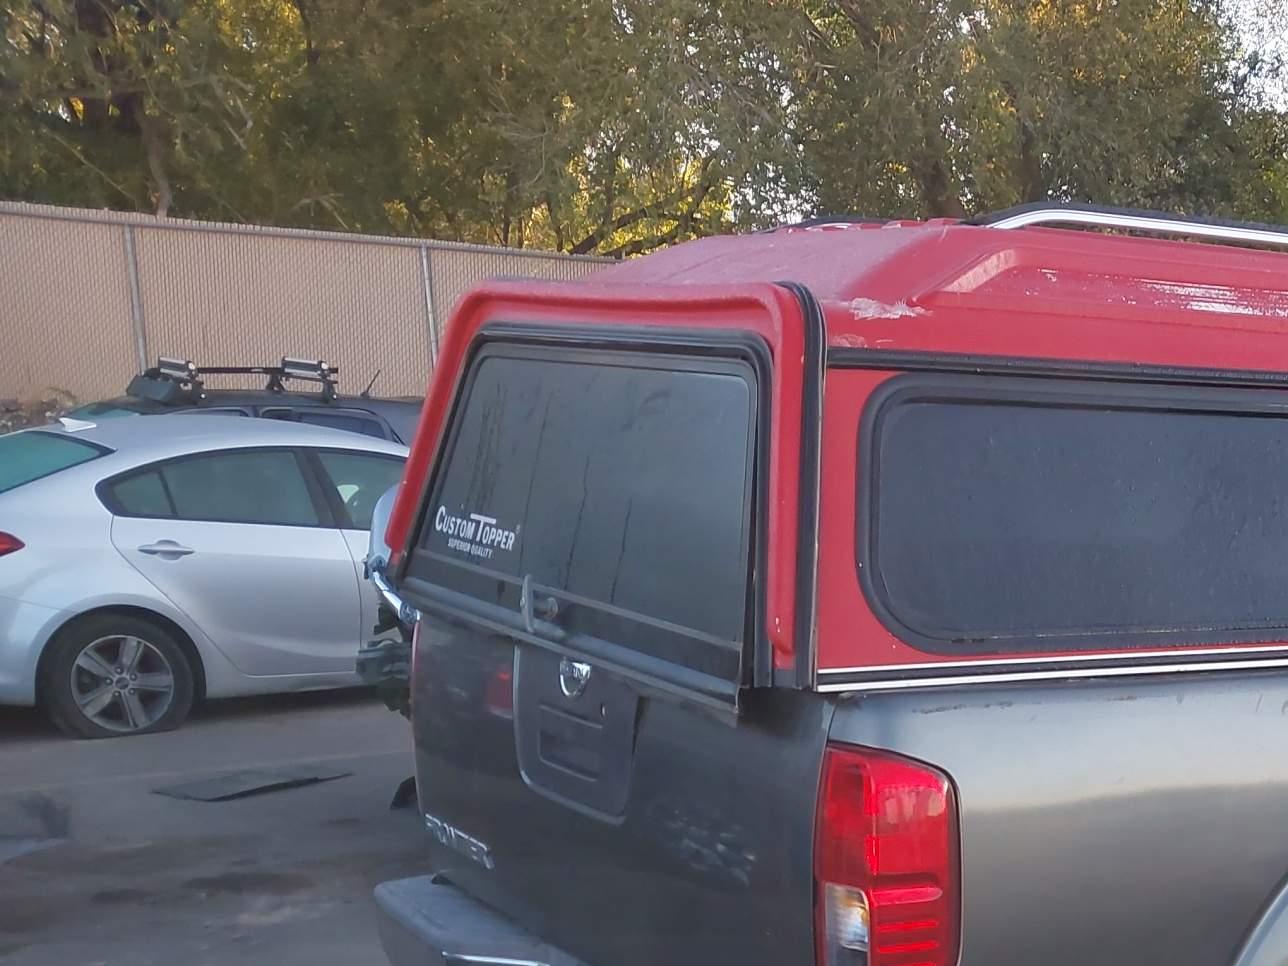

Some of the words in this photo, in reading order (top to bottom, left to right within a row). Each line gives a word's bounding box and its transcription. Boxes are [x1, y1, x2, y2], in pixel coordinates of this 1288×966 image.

[435, 505, 476, 540] CUSTOM
[469, 513, 515, 551] TOPPER
[448, 538, 471, 552] SUPERIOR
[470, 544, 493, 558] QUALITY
